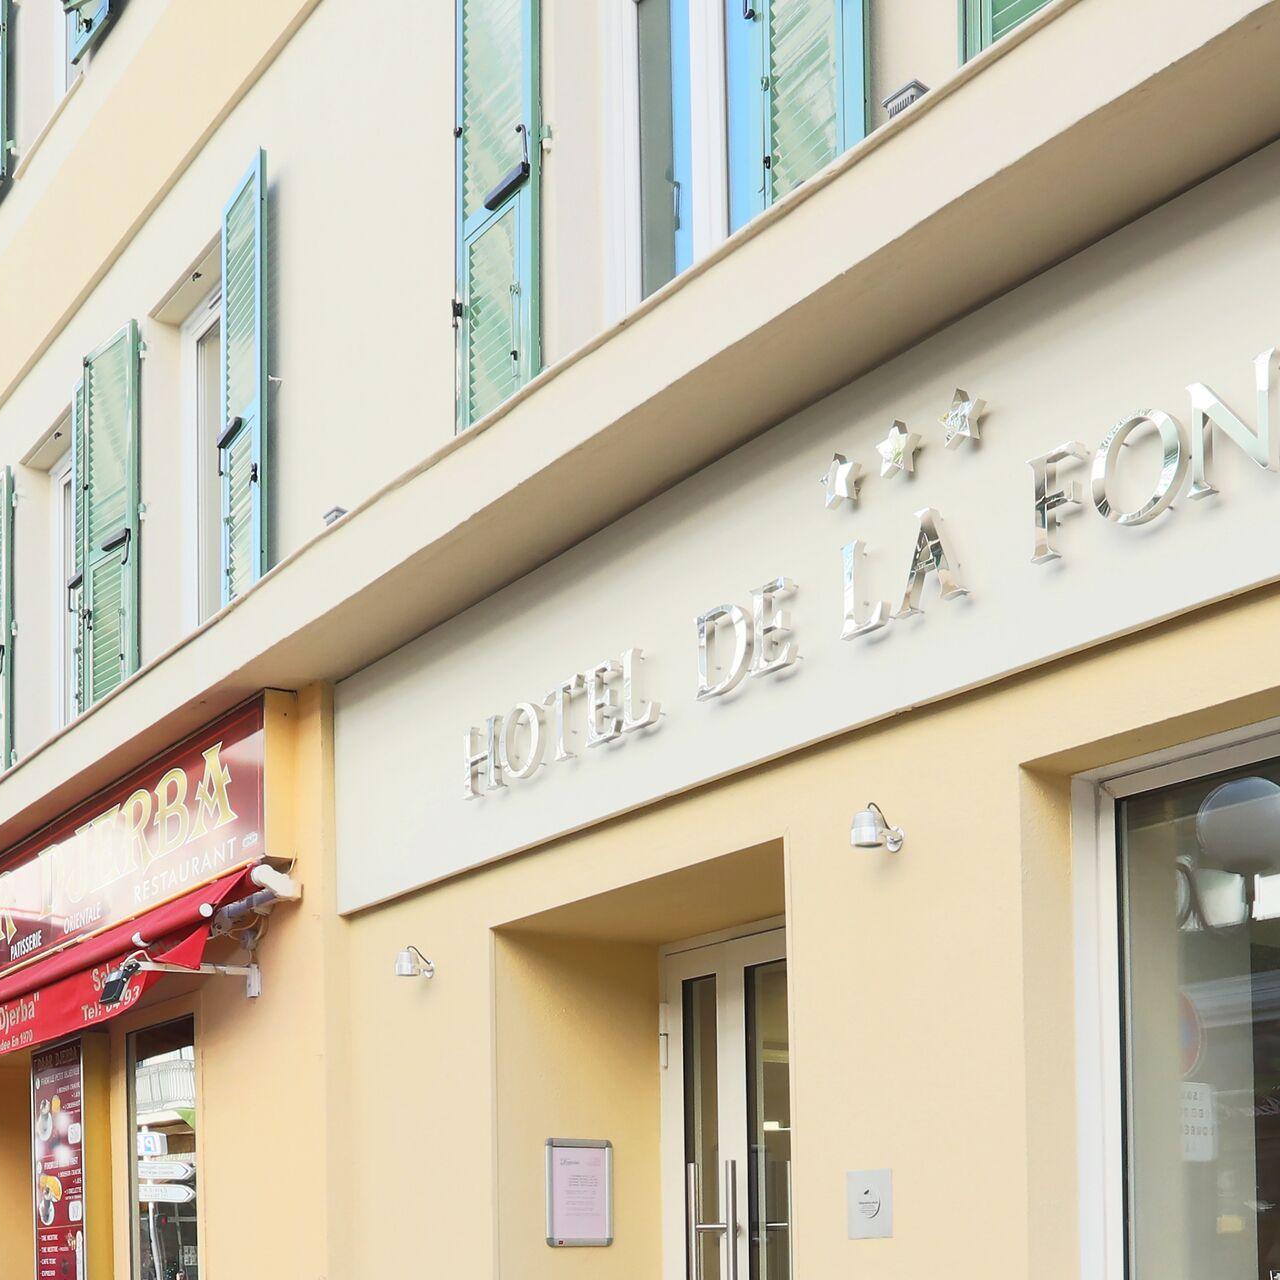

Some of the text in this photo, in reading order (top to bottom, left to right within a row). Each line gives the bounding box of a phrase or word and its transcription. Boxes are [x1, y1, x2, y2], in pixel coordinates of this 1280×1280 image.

[462, 646, 665, 801] HOTEL
[694, 575, 804, 702] DE
[839, 506, 973, 641] LA
[133, 836, 238, 905] RESTAURANT
[63, 902, 102, 935] ORIENTALE
[10, 929, 42, 962] PATISSERIE
[124, 985, 140, 1006] 93
